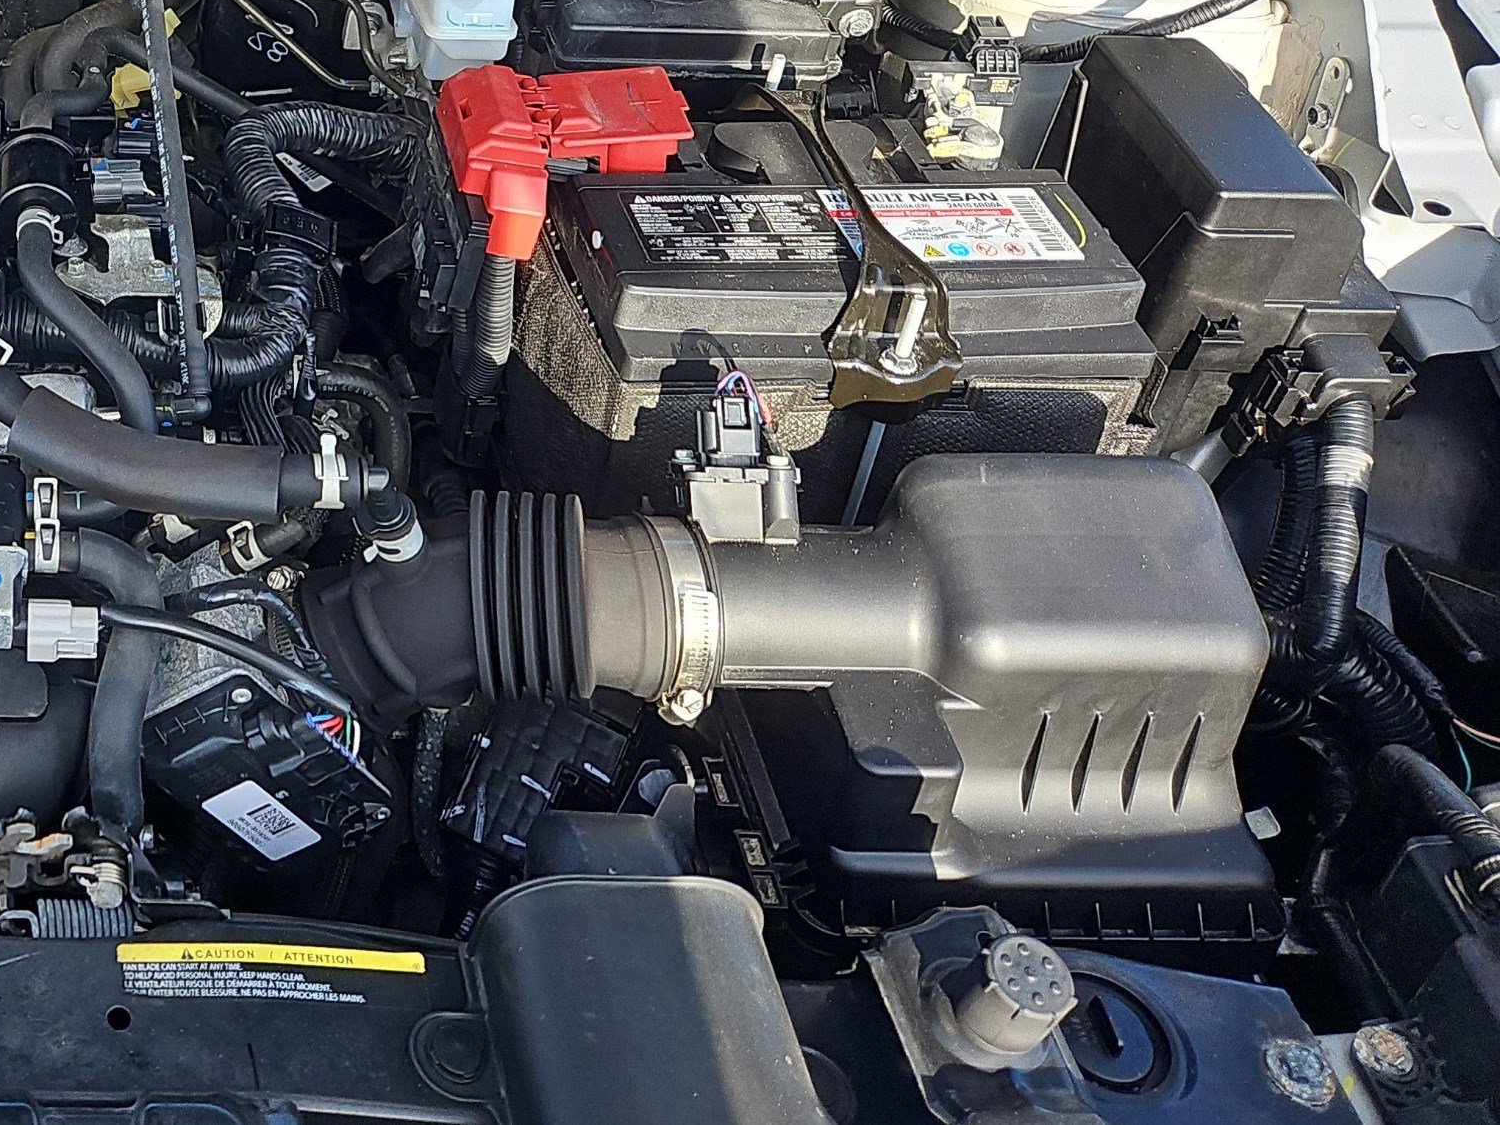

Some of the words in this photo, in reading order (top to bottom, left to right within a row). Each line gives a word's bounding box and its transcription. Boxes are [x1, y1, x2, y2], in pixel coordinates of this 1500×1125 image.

[645, 195, 715, 203] DANGER/POISON
[731, 194, 803, 202] PELIGRO/VENENO
[908, 192, 999, 202] NISSAN
[194, 949, 255, 959] CAUTION
[283, 951, 355, 964] ATTENTION
[122, 963, 137, 971] FAN
[138, 963, 160, 971] BLADE
[161, 963, 176, 971] CAN
[177, 963, 198, 971] START
[199, 963, 208, 971] AT
[209, 963, 223, 971] ANY
[124, 971, 134, 980] TO
[135, 971, 152, 980] HELP
[153, 971, 175, 980] AVOID
[176, 971, 212, 980] PERSONAL
[239, 971, 256, 980] KEEP
[257, 971, 281, 981] HANDS
[124, 980, 134, 988] LE
[134, 980, 185, 988] VENTILATEUR
[186, 980, 213, 989] RISQUE
[215, 980, 225, 988] DE
[276, 981, 295, 990] TOUT
[148, 987, 174, 996] ÉVITER
[175, 988, 200, 996] TOUTE
[241, 988, 252, 997] NE
[253, 989, 267, 997] PAS
[268, 989, 279, 997] EN
[280, 990, 325, 1000] APPROCHER
[326, 992, 338, 1001] LES
